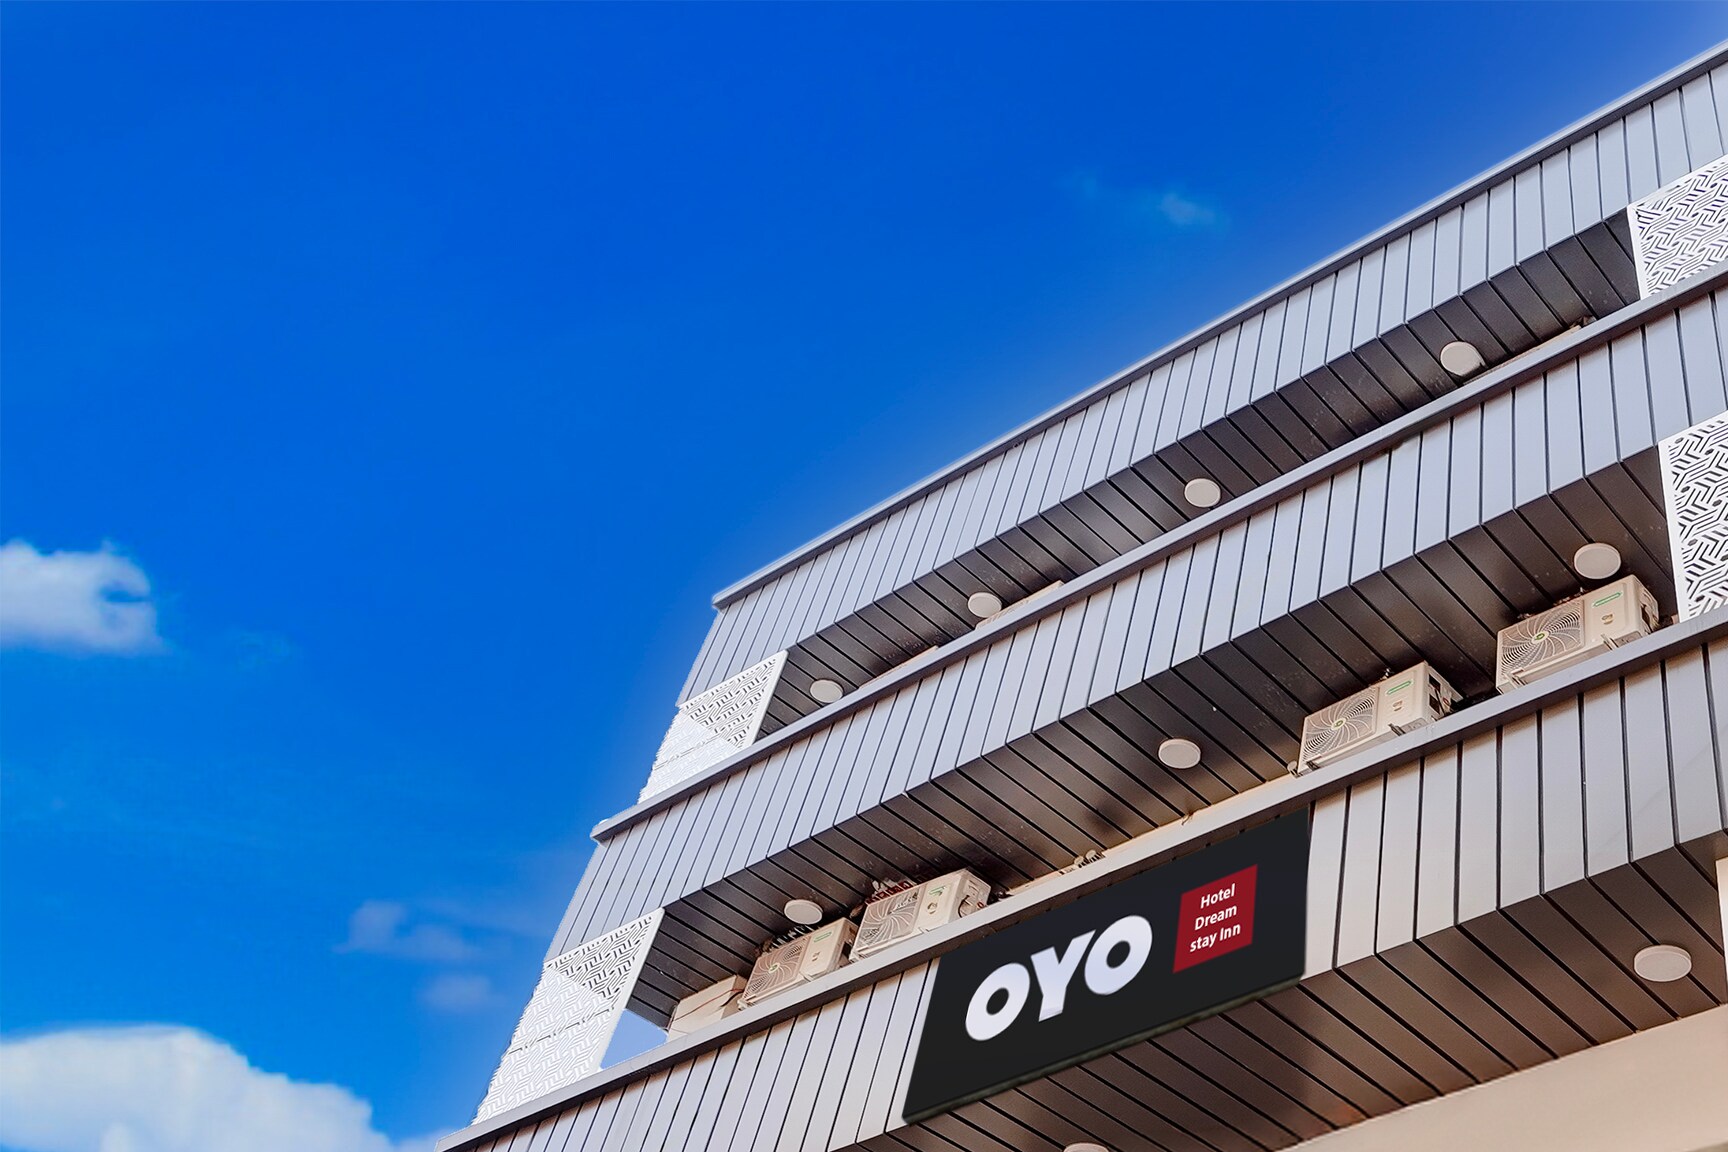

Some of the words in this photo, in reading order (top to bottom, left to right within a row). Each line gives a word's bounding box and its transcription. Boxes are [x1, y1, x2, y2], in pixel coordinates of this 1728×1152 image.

[1200, 883, 1236, 909] Hotel
[1194, 903, 1238, 931] Dream
[1189, 931, 1217, 953] stay
[1219, 922, 1241, 942] Inn
[965, 915, 1153, 1042] OYO
